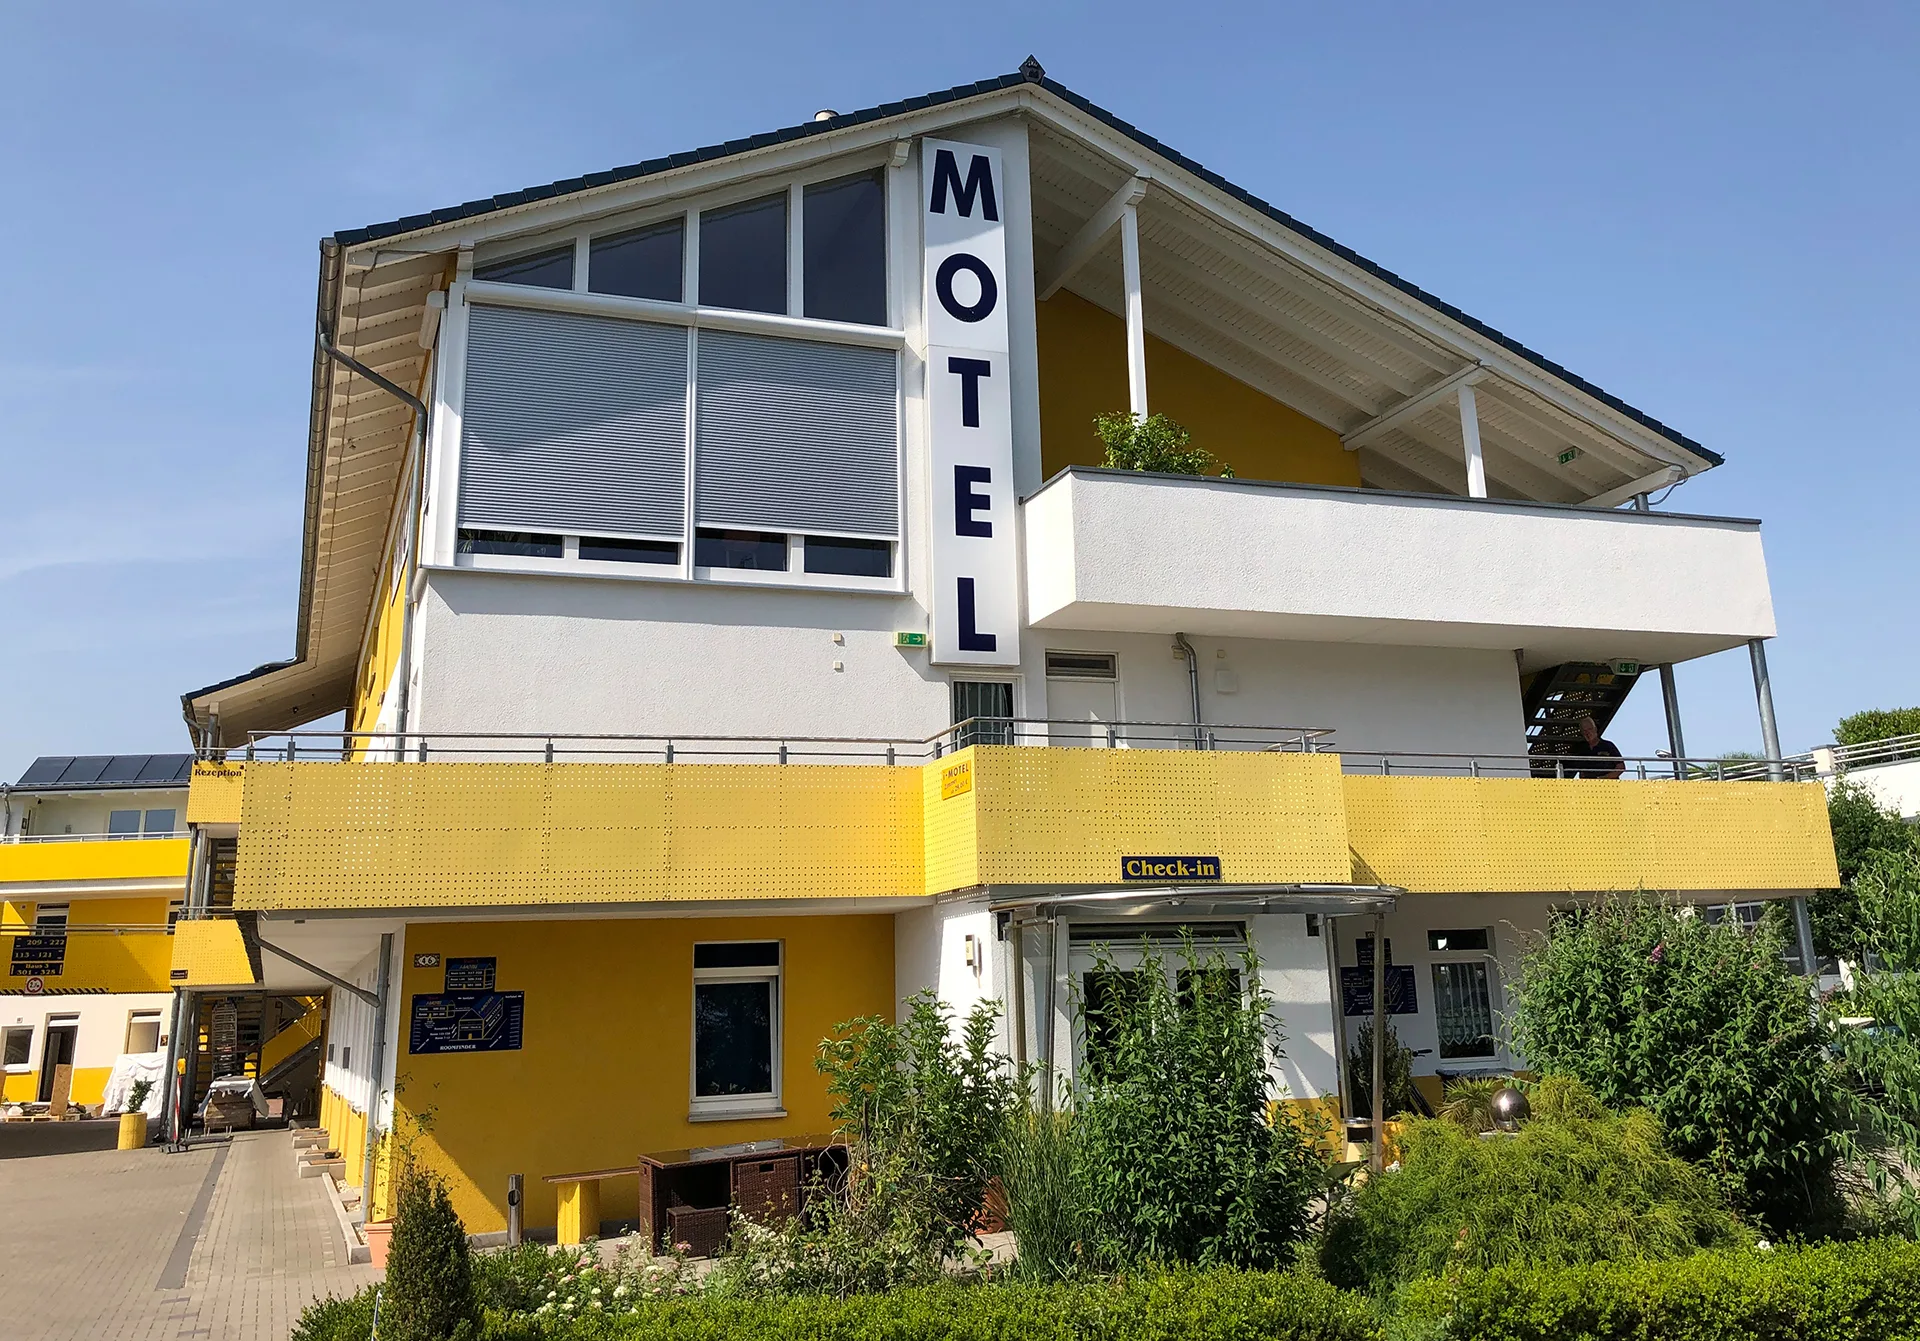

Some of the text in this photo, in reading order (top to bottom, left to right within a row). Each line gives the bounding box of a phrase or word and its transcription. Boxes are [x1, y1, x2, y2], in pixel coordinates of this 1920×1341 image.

[928, 148, 1000, 653] MOTEL
[195, 769, 242, 778] Rezeption
[1126, 860, 1216, 877] Check-in
